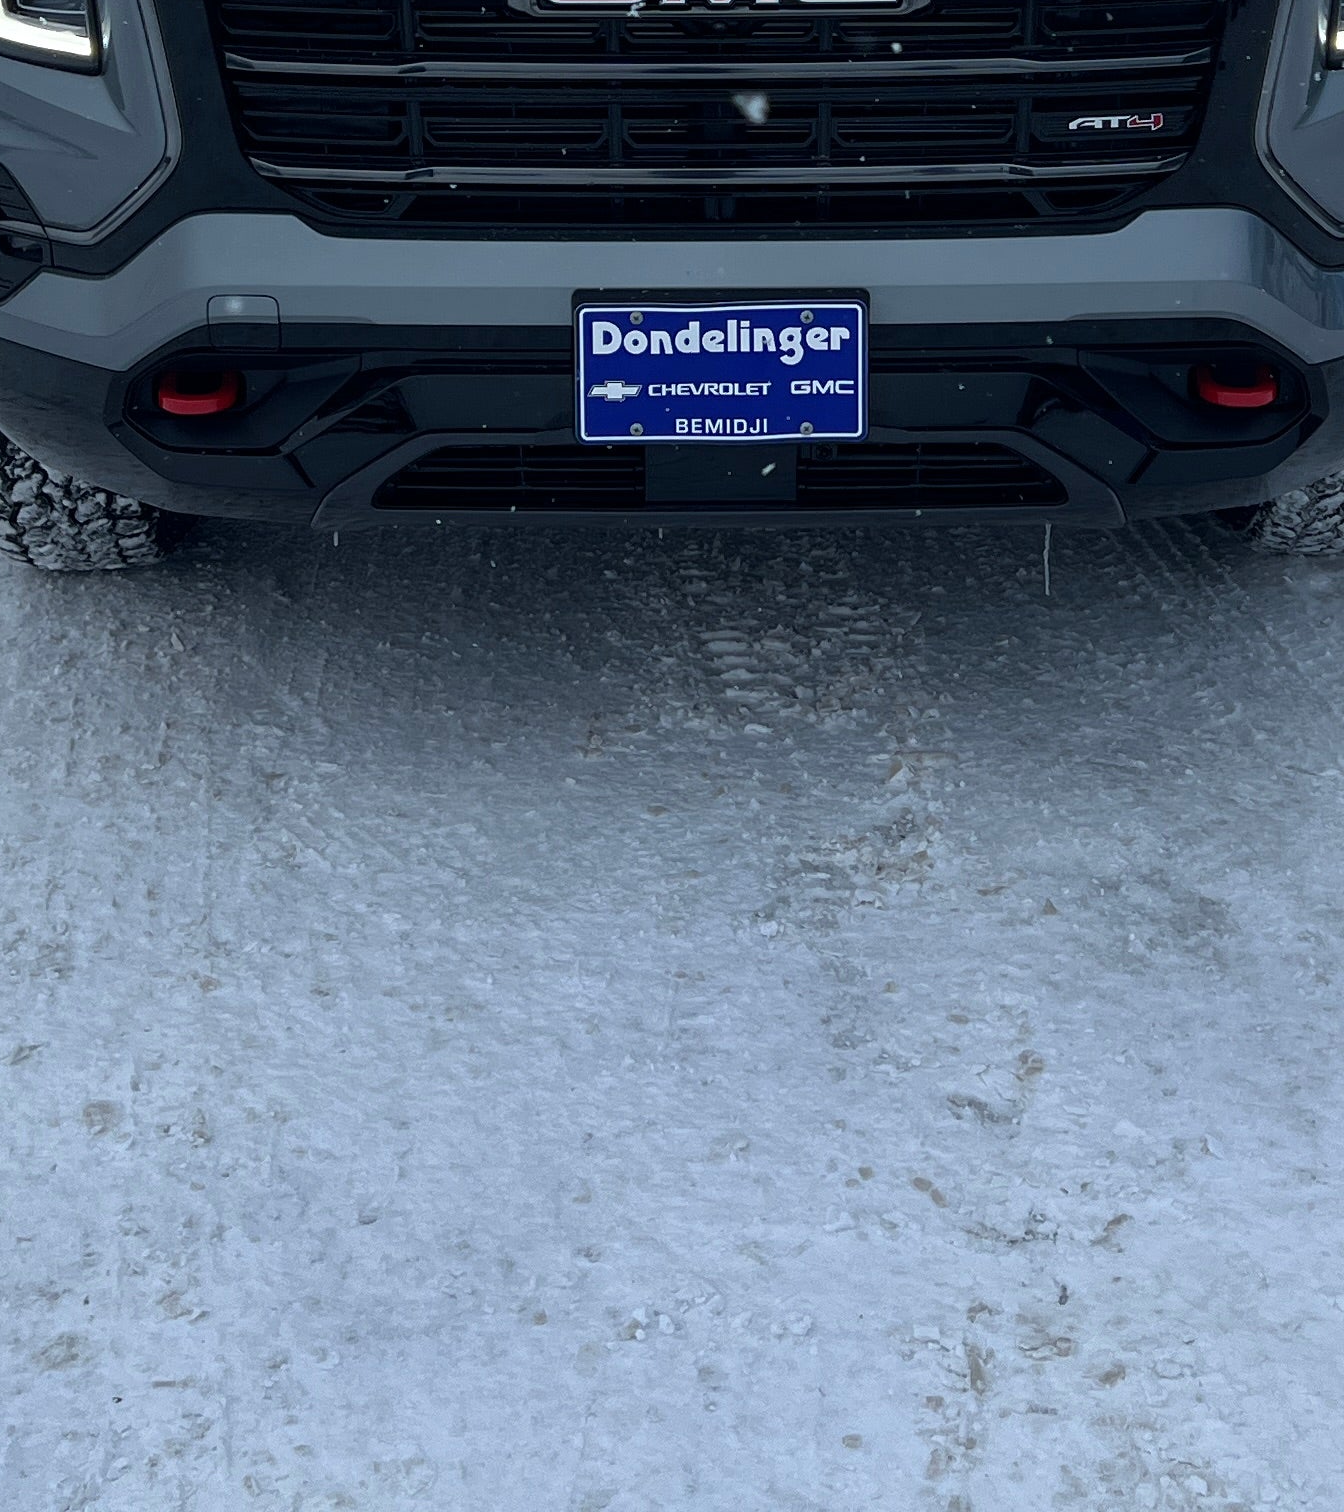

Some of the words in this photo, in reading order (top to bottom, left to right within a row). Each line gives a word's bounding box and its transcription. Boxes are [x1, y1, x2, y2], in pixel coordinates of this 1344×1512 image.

[1068, 113, 1164, 130] AT4
[592, 319, 850, 365] Dondelinger
[648, 381, 772, 396] CHEVROLET
[790, 380, 855, 395] GMC
[675, 418, 768, 434] BEMIDJI
